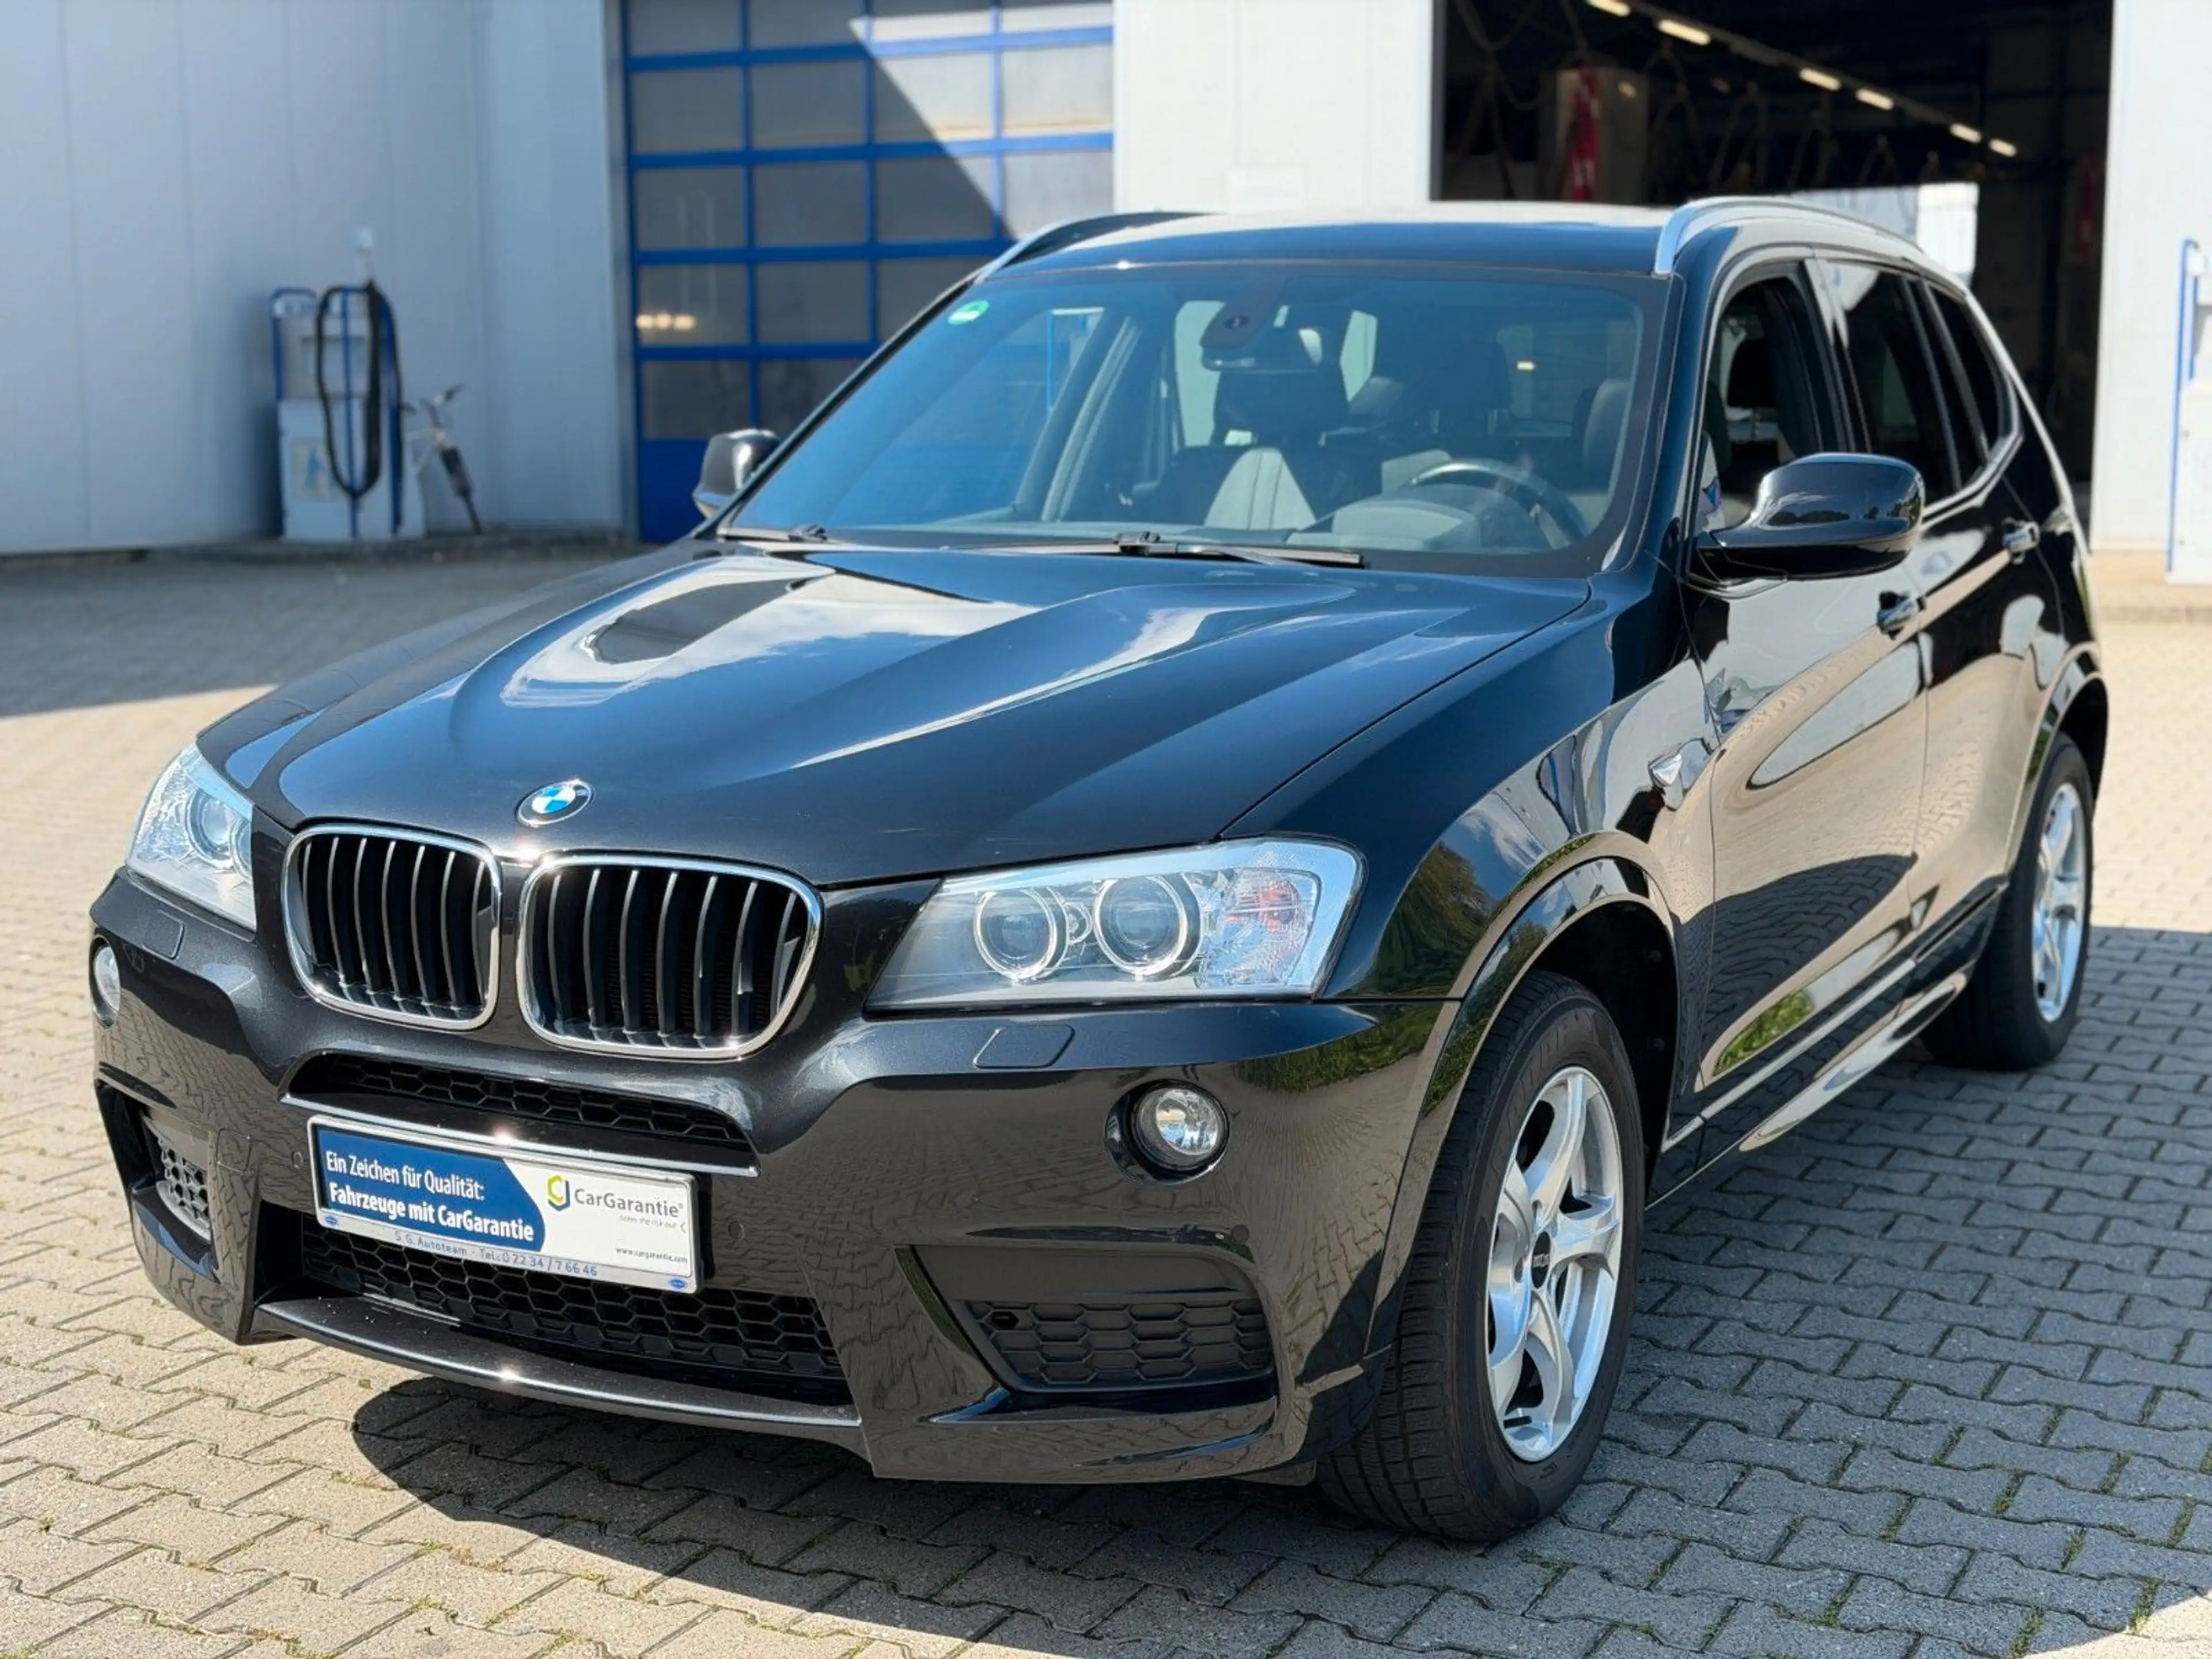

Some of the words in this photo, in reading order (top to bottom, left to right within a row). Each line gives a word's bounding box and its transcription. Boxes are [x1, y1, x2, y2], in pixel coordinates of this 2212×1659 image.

[326, 1151, 346, 1173] Ein
[349, 1154, 399, 1184] Zeichen
[402, 1165, 422, 1189] für
[425, 1169, 484, 1200] Qualität:
[329, 1182, 406, 1220] Fahrzeuge
[408, 1202, 435, 1224] mit
[438, 1205, 534, 1242] CarGarantie
[418, 1237, 468, 1256] Autoteam
